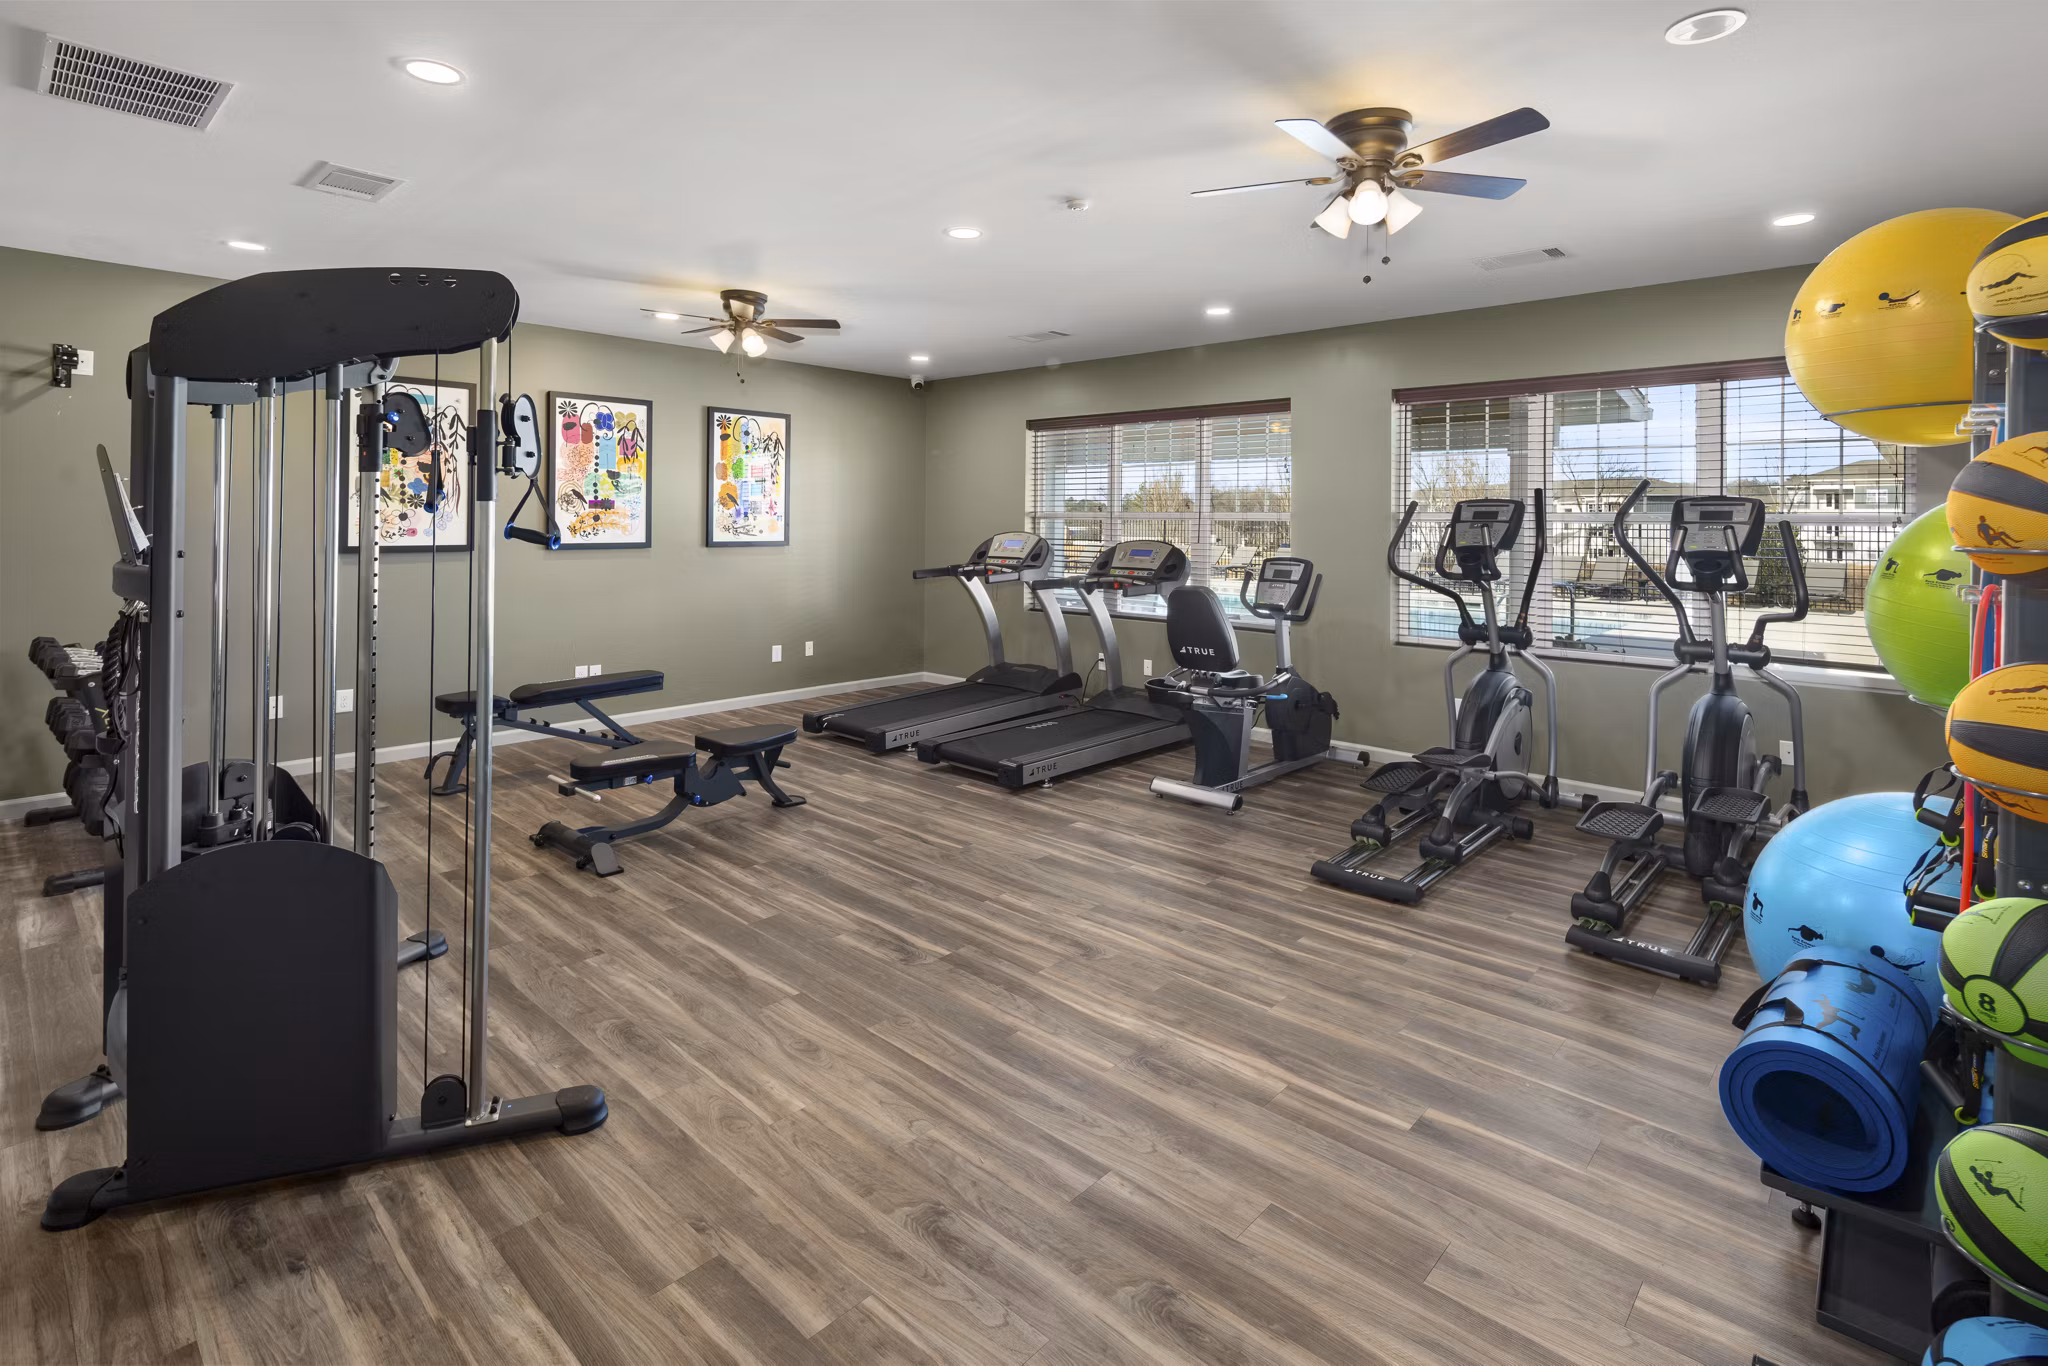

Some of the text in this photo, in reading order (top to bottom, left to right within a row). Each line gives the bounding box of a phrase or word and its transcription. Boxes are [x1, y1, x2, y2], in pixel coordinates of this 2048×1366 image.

[1186, 646, 1215, 656] TRUE
[898, 729, 920, 741] TRUE
[1036, 762, 1058, 774] TRUE
[1223, 780, 1244, 792] TRUE
[1981, 838, 1989, 858] Smart
[1355, 869, 1386, 881] TRUE
[1626, 939, 1669, 954] TRUE
[1978, 993, 1997, 1013] 8
